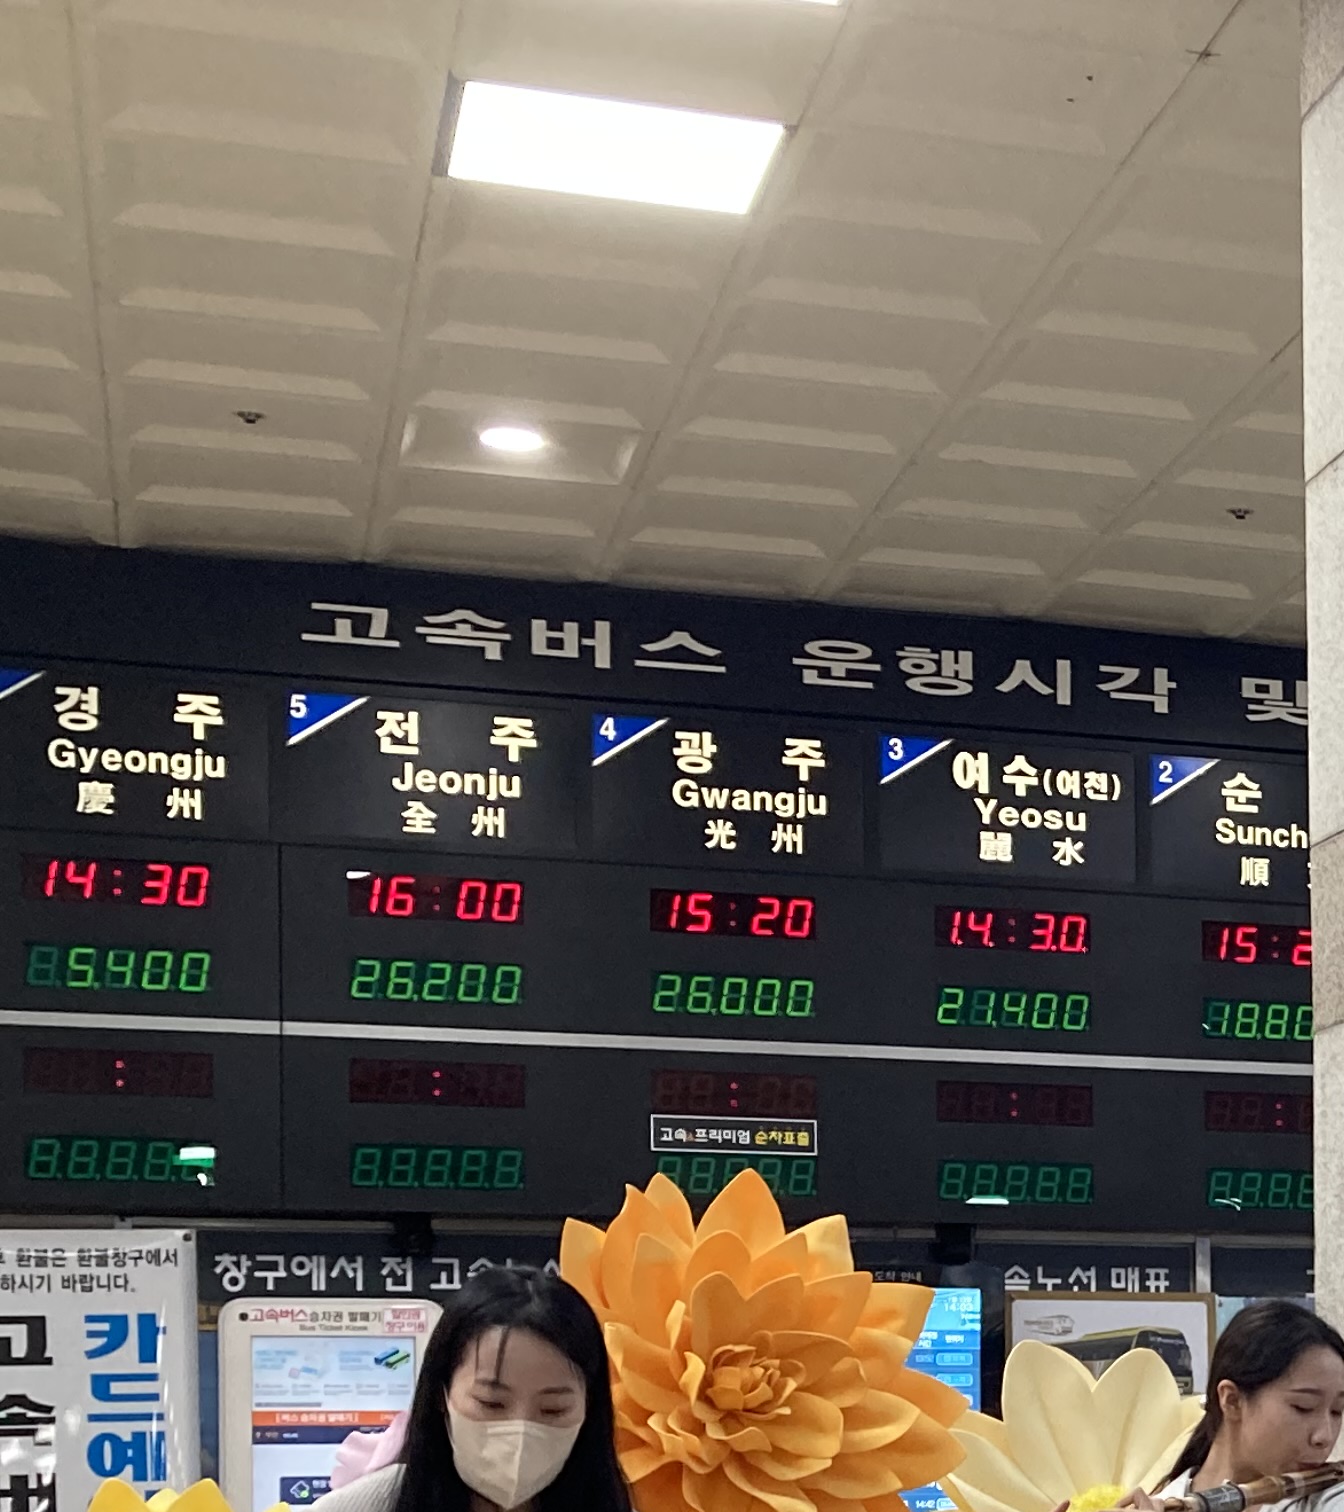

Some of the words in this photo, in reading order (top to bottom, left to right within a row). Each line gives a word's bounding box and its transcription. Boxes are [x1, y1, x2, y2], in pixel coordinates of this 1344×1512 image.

[301, 602, 727, 674] 고속버스
[792, 638, 1177, 714] 운행시각
[1240, 677, 1309, 726] 및
[289, 694, 307, 719] 5
[599, 717, 617, 741] 4
[47, 740, 226, 780] Gyeongju
[888, 738, 904, 760] 3
[392, 762, 521, 799] Jeonju
[1158, 761, 1173, 784] 2
[671, 780, 828, 818] Gwangju
[1221, 772, 1263, 814] 순
[974, 798, 1087, 833] Yeosu
[1215, 817, 1308, 849] Sunch
[42, 859, 211, 908] 14:30
[367, 873, 523, 924] 16:00
[669, 892, 815, 940] 15:20
[949, 907, 1090, 954] 14:30
[694, 1127, 750, 1145] 프리미엄
[61, 1273, 137, 1293] 바랍니다.
[214, 1253, 363, 1292] 창구에서
[380, 1256, 413, 1292] 전
